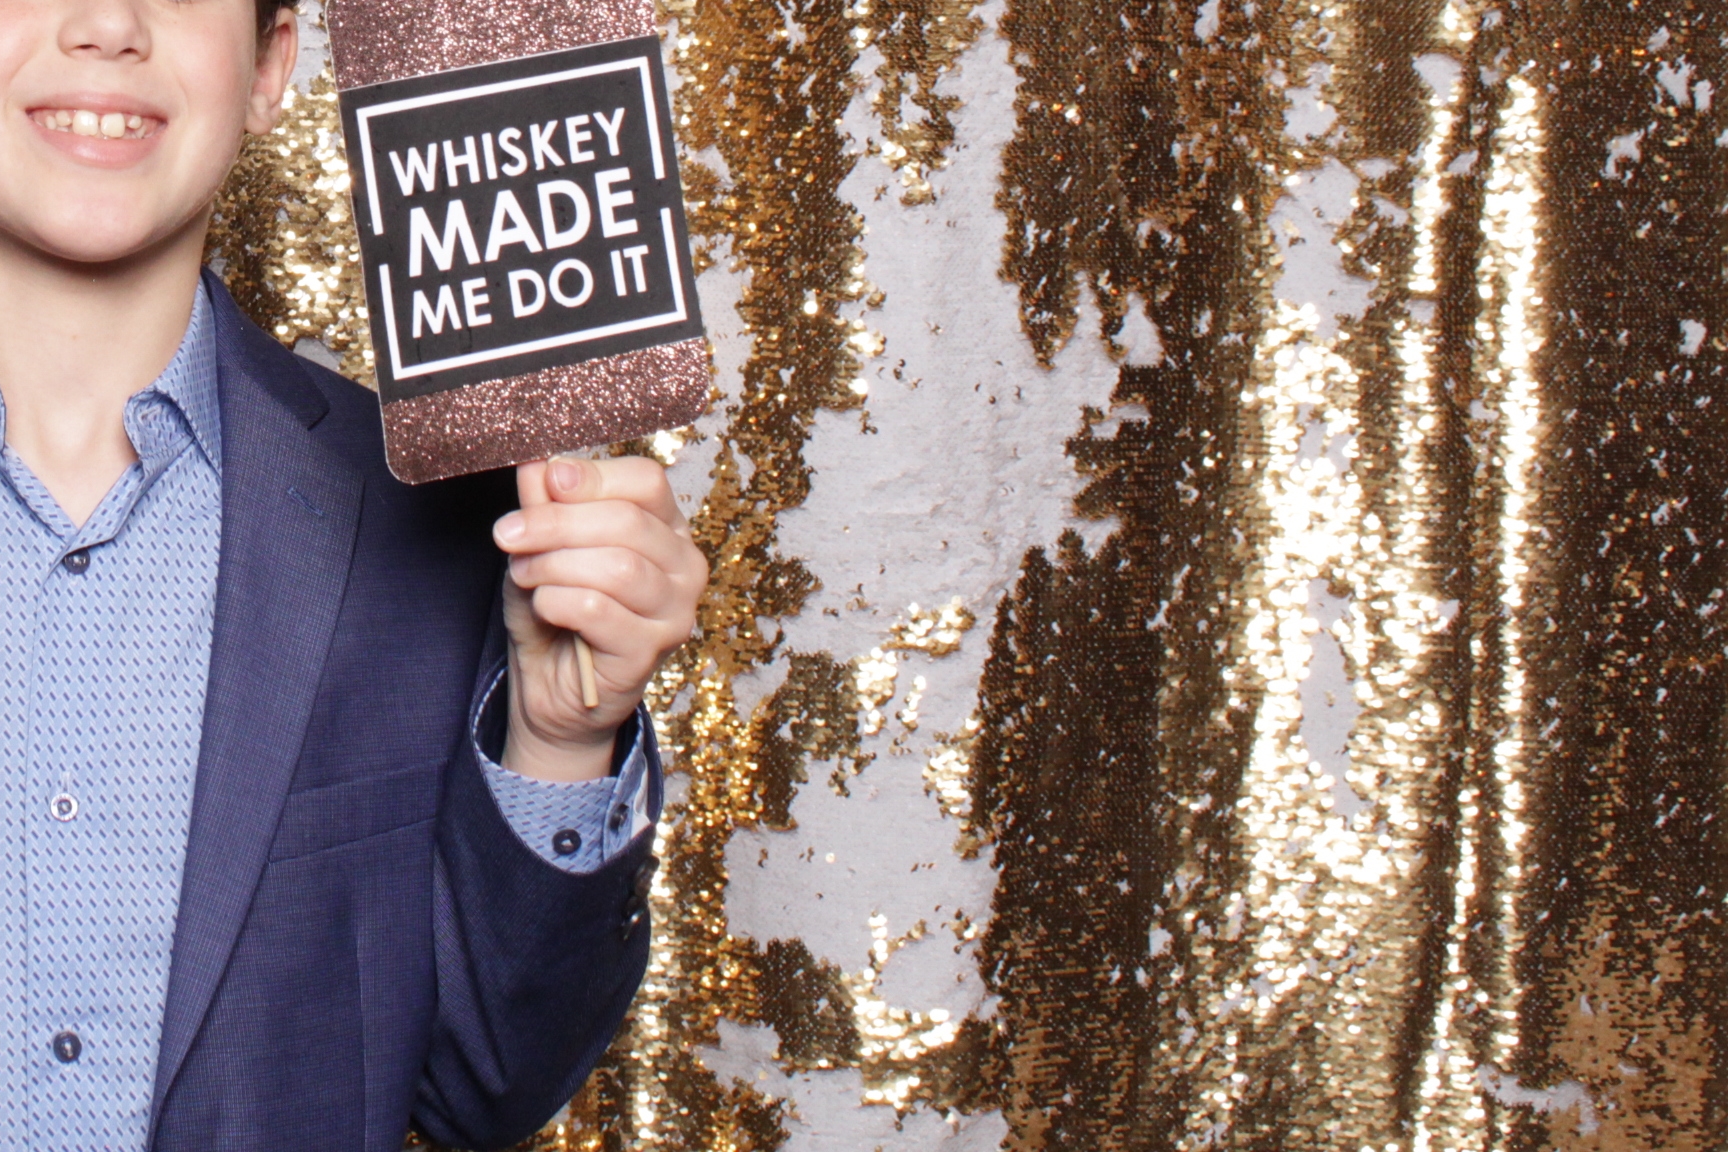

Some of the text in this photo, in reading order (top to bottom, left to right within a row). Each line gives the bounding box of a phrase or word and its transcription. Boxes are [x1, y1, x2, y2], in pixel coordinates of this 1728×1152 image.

[388, 107, 626, 197] WHISKEY
[408, 167, 639, 278] MADE
[411, 244, 649, 339] ME DO IT
